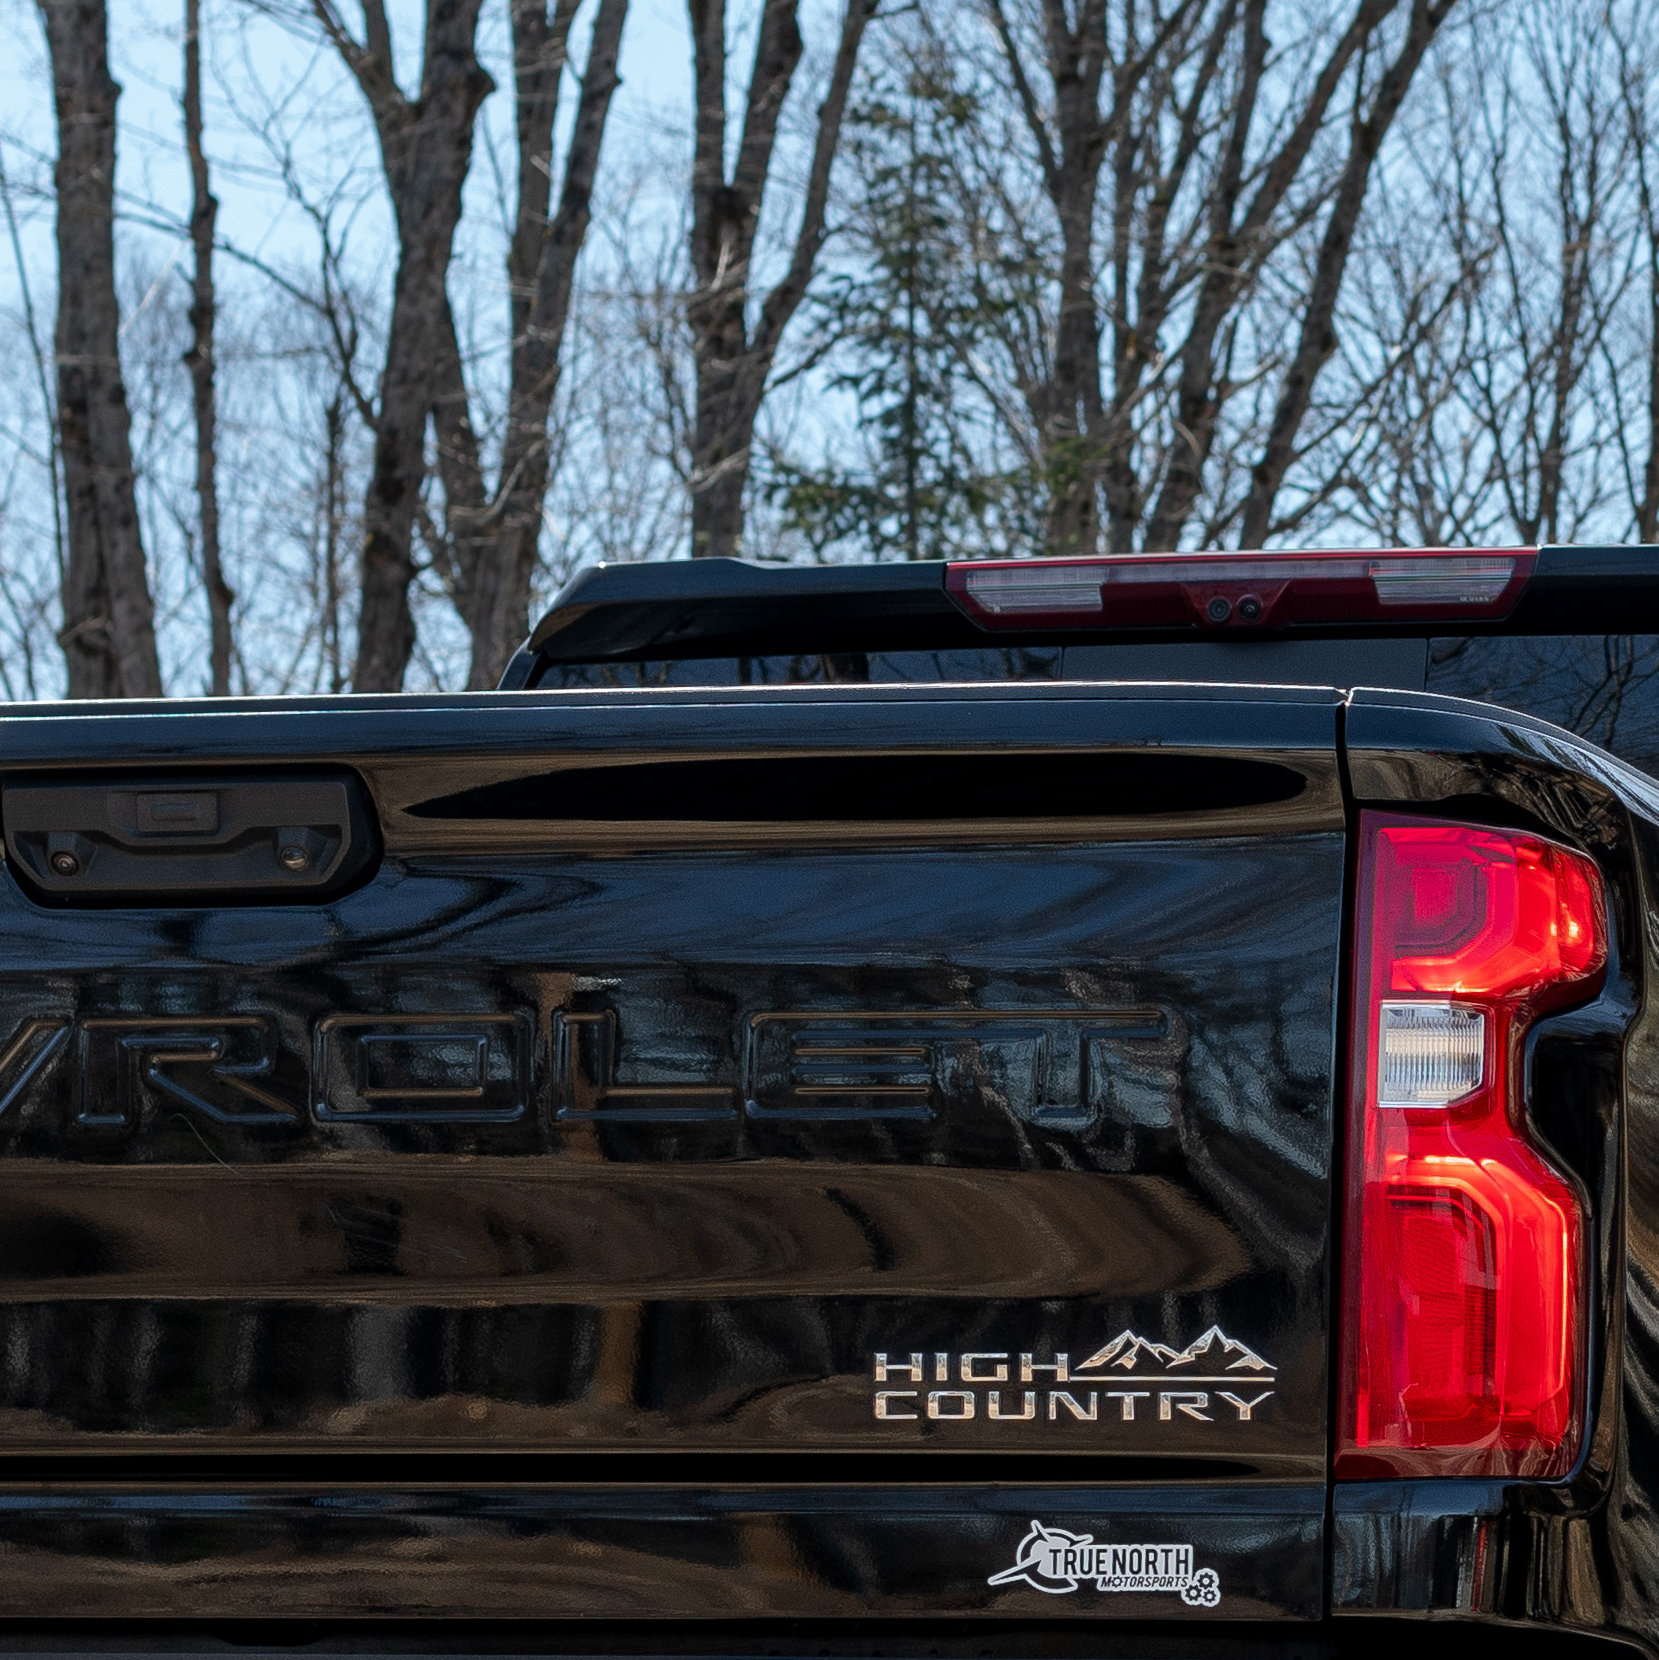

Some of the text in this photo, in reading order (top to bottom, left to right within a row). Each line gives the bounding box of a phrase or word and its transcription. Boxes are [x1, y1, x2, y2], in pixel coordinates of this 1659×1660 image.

[873, 1352, 1069, 1382] HIGH
[873, 1390, 1276, 1421] COUNTRY
[1100, 1576, 1189, 1589] MOTORSPORTS
